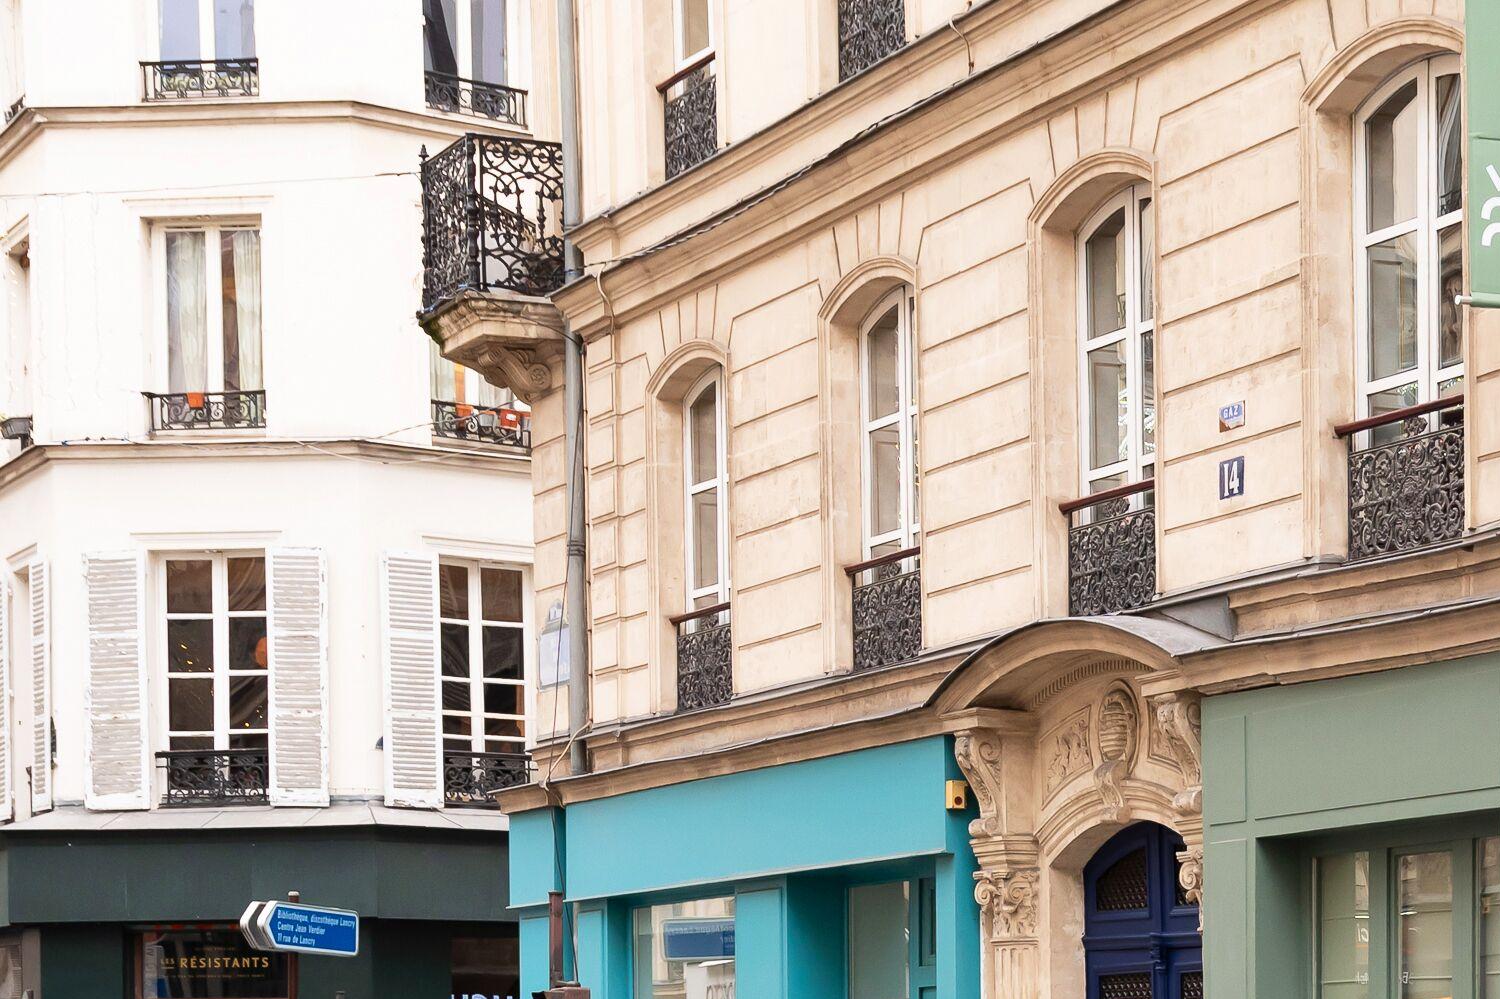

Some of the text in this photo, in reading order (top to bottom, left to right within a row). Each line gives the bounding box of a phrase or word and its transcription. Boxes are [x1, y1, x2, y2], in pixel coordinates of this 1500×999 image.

[1222, 404, 1240, 419] GAZ
[1222, 461, 1240, 497] 14
[278, 922, 326, 935] Centre Jean Verdier
[340, 917, 355, 929] Lancry
[278, 933, 315, 946] 11 rue de Lancry
[180, 955, 270, 969] RÉSISTANTS
